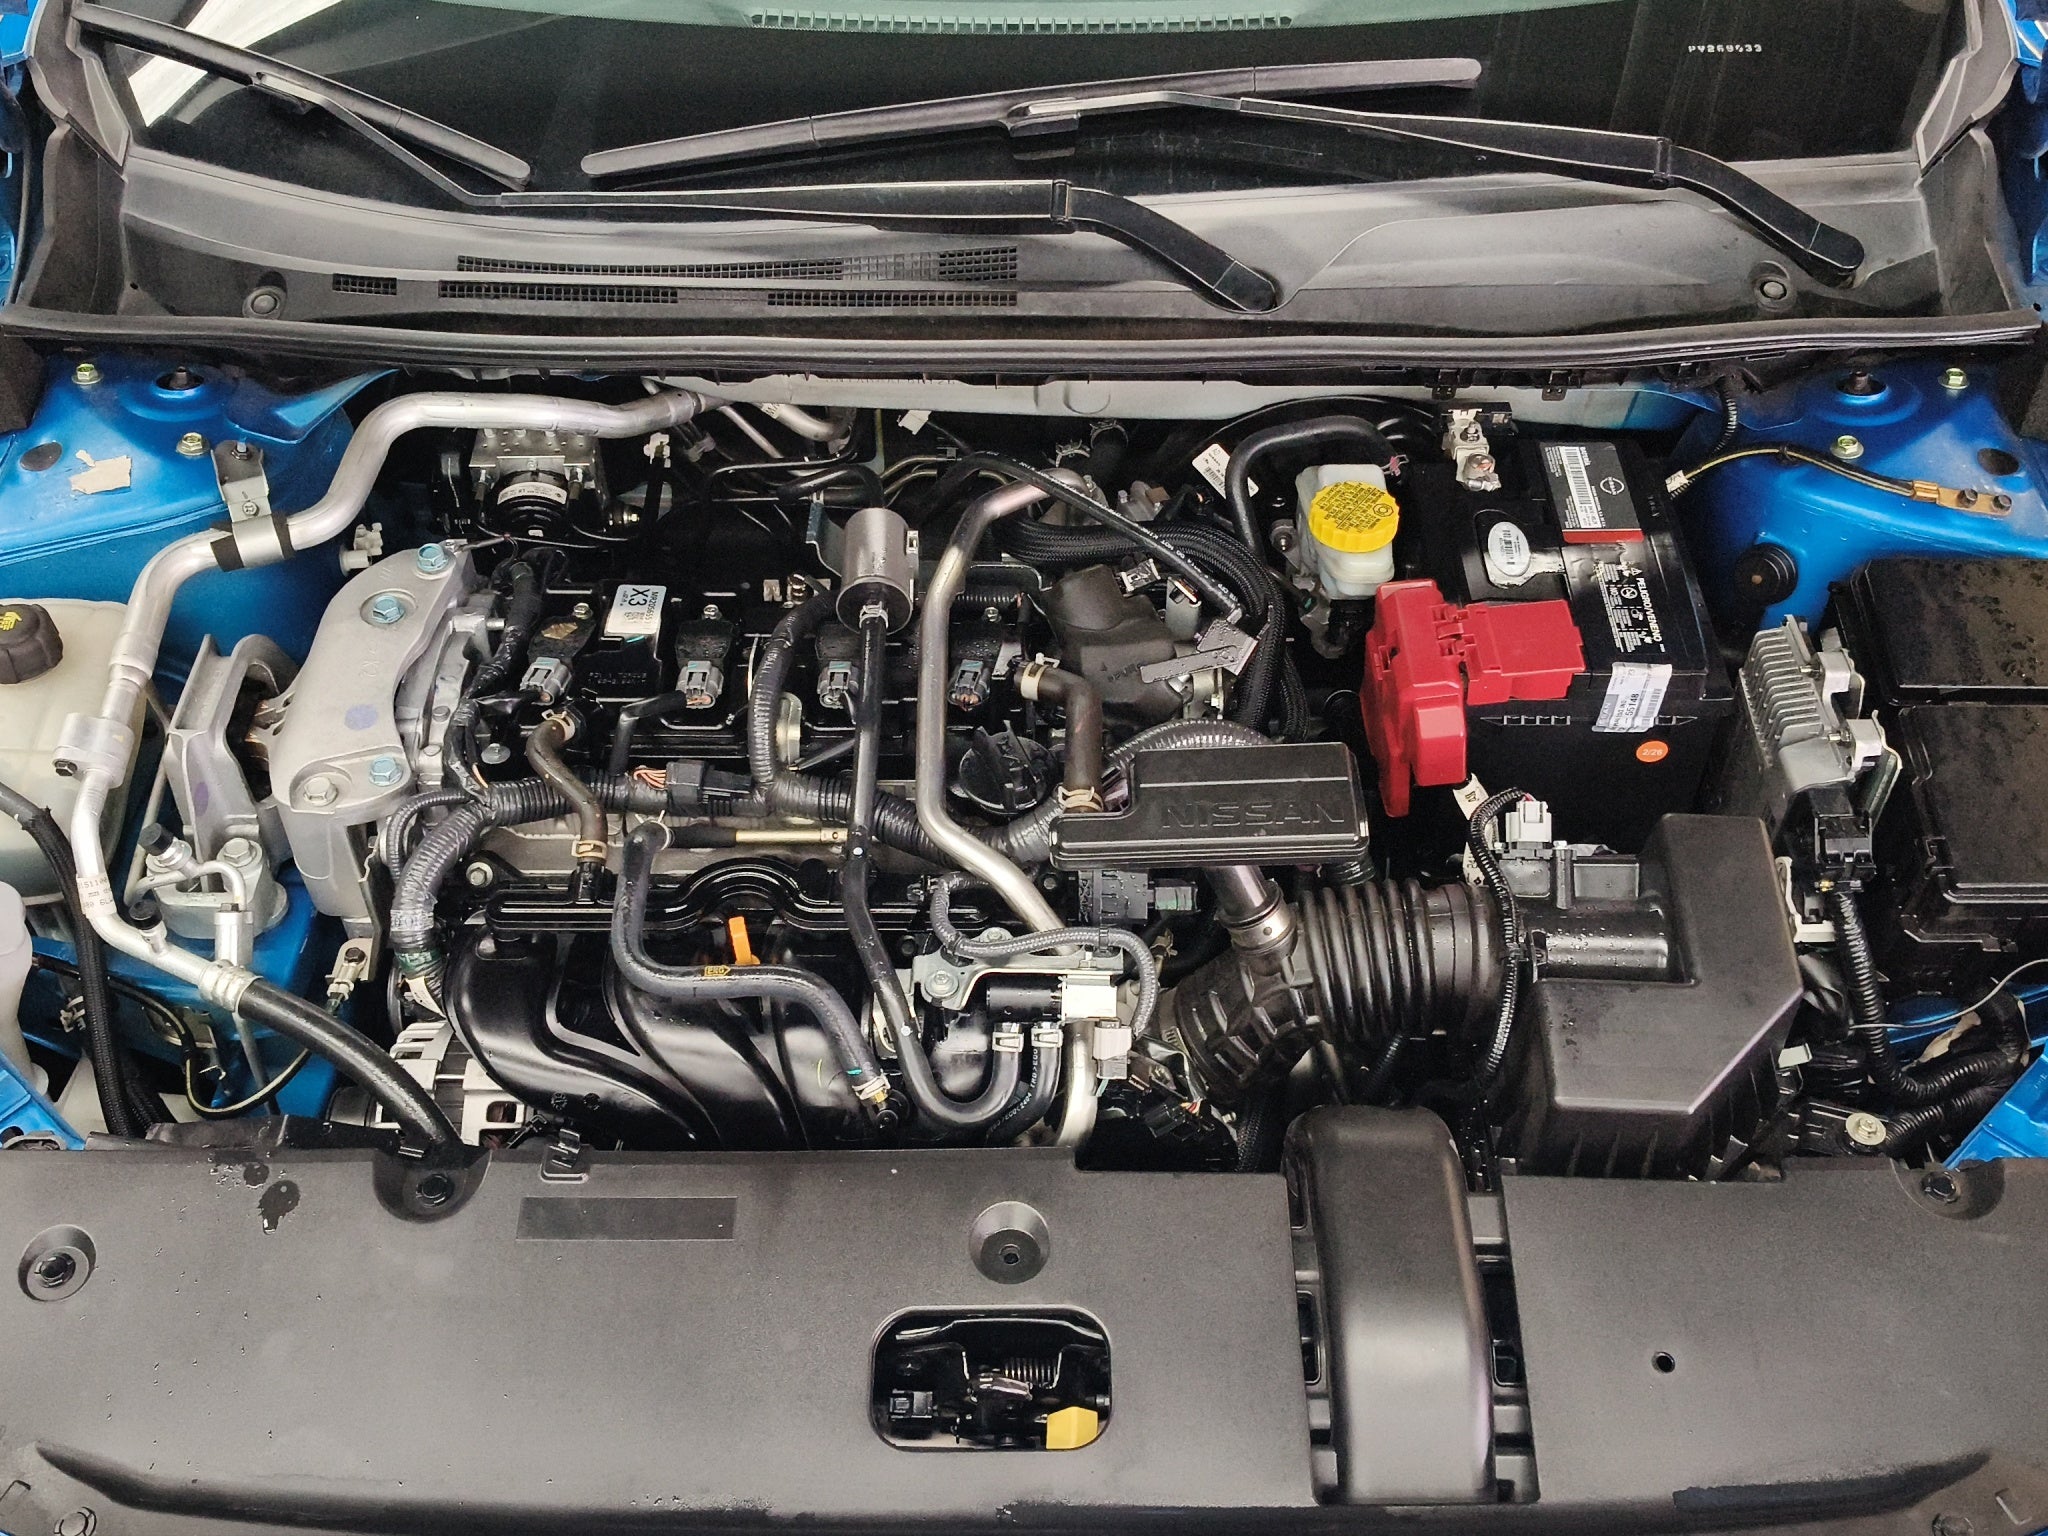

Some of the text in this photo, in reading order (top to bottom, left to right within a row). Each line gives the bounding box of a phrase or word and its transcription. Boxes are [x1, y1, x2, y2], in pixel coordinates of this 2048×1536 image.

[628, 588, 650, 606] X3
[1636, 577, 1662, 642] PELIGRO/VENENO
[1642, 748, 1664, 756] 2/26
[1161, 801, 1345, 828] NISSAN
